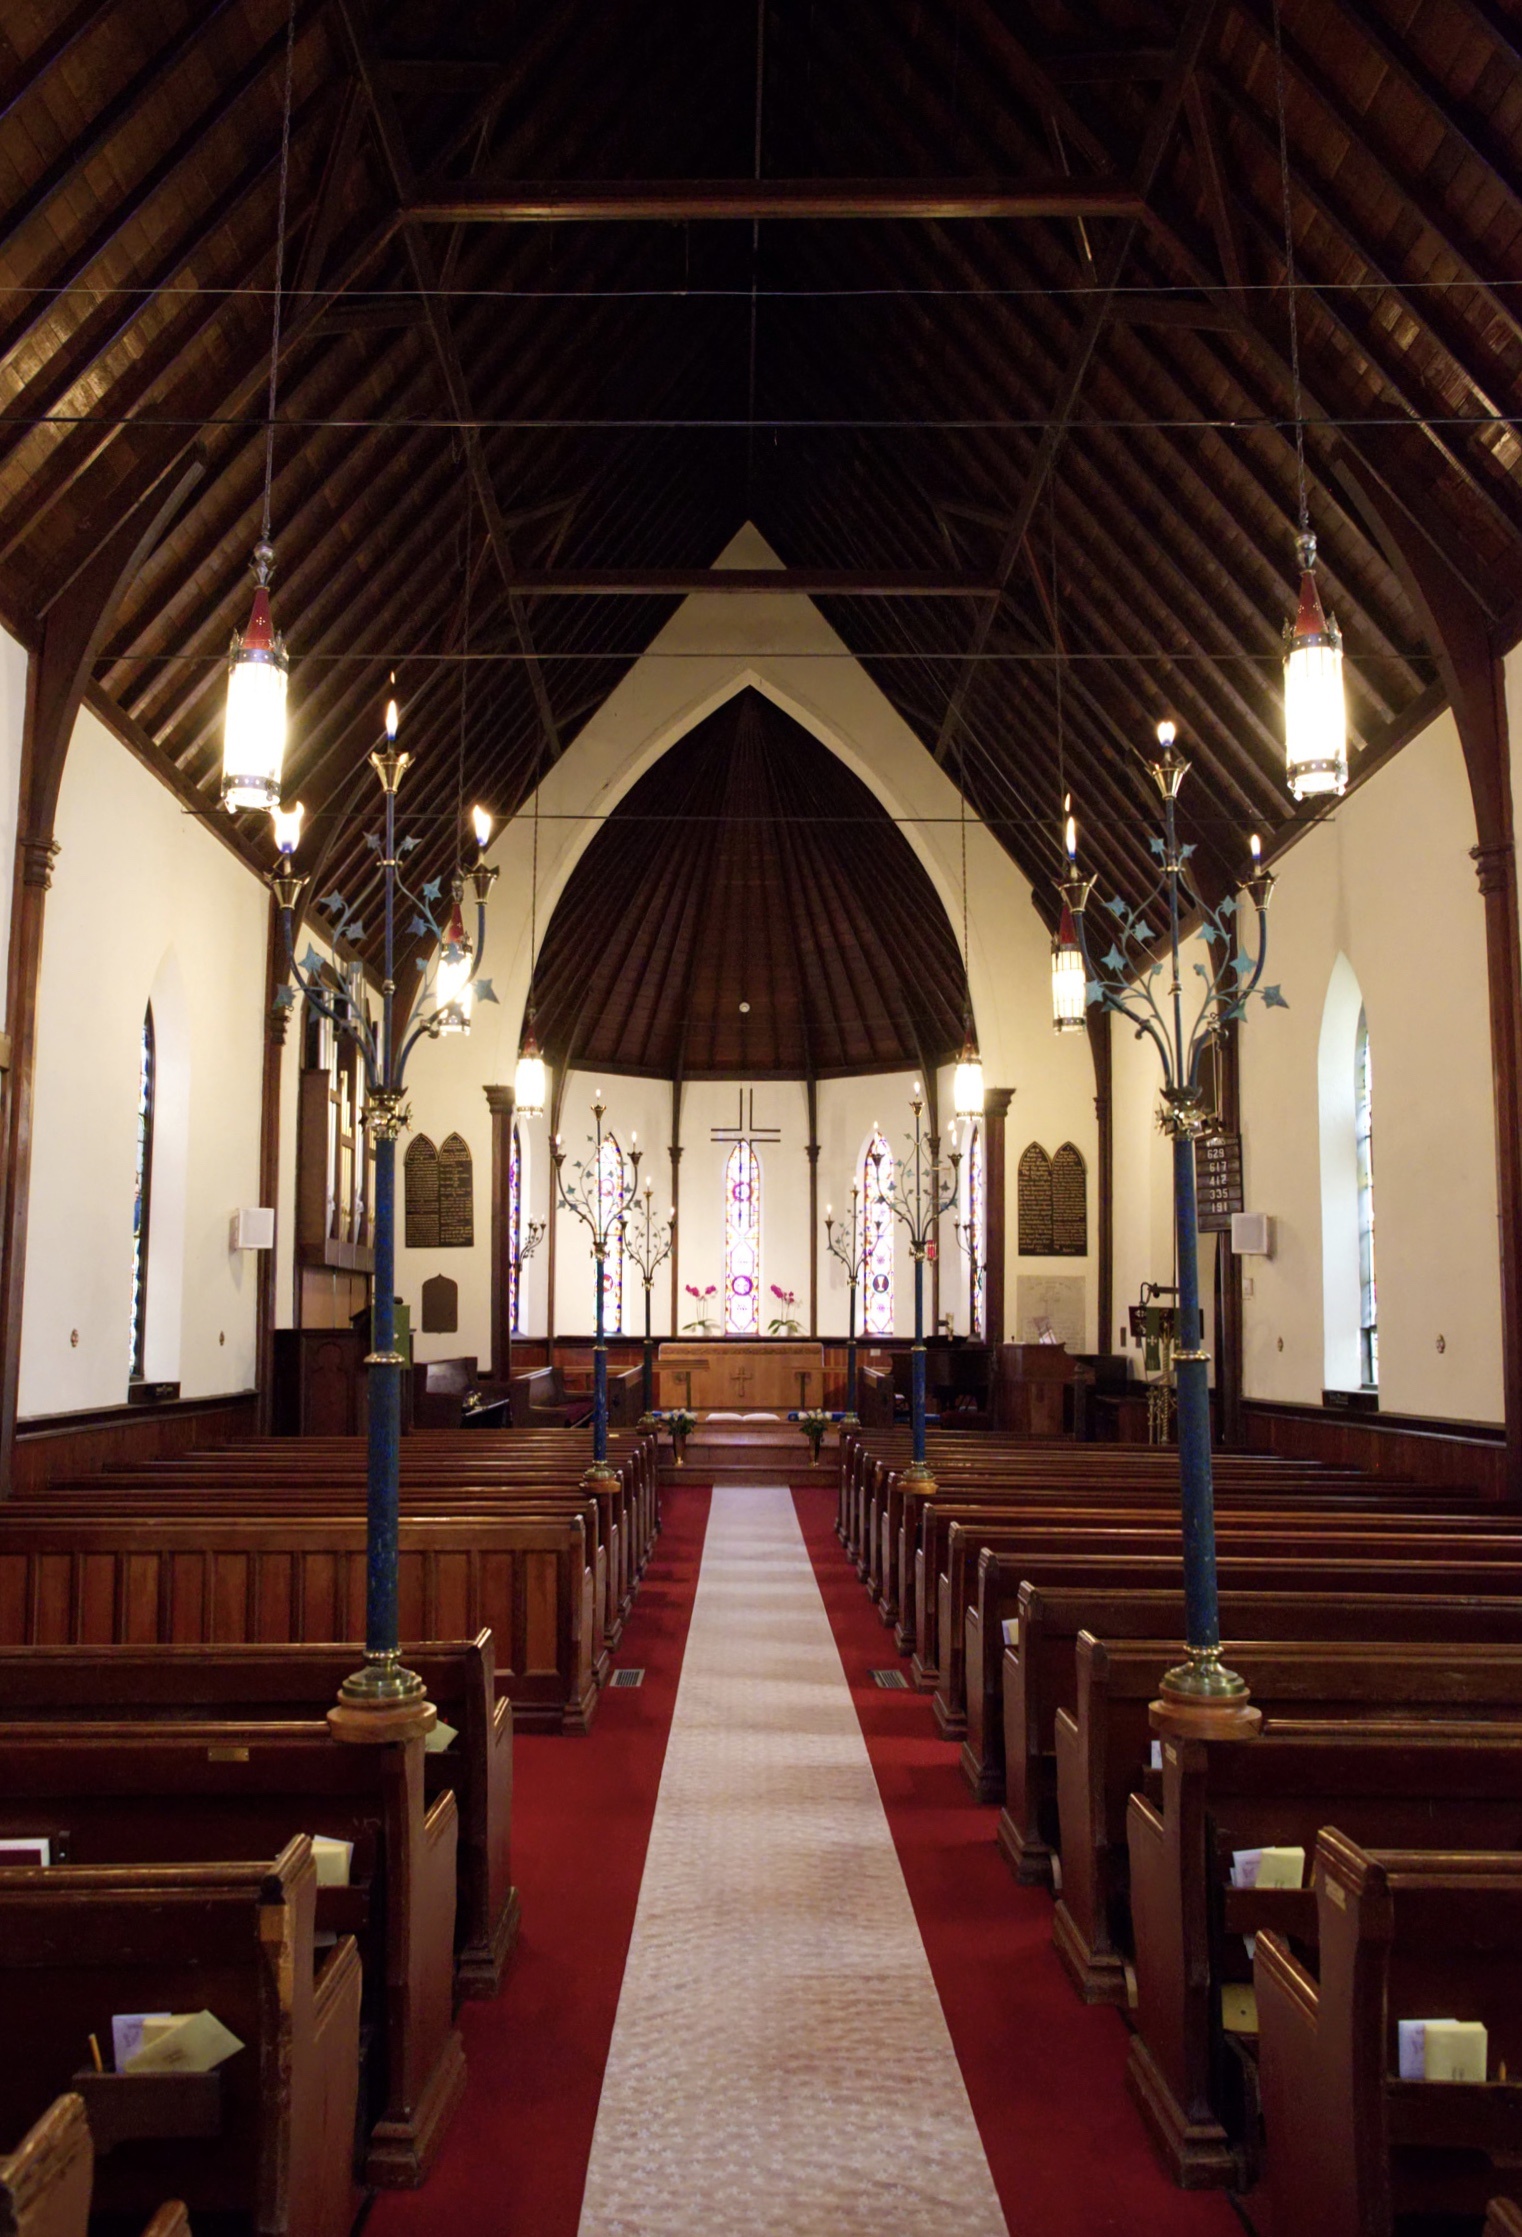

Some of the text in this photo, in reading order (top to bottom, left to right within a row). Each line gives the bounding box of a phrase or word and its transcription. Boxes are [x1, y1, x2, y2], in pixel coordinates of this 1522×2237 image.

[1207, 1148, 1225, 1160] 629
[1209, 1161, 1227, 1173] 617
[1209, 1174, 1227, 1187] 412
[1209, 1188, 1228, 1200] 335
[1211, 1202, 1228, 1213] 191
